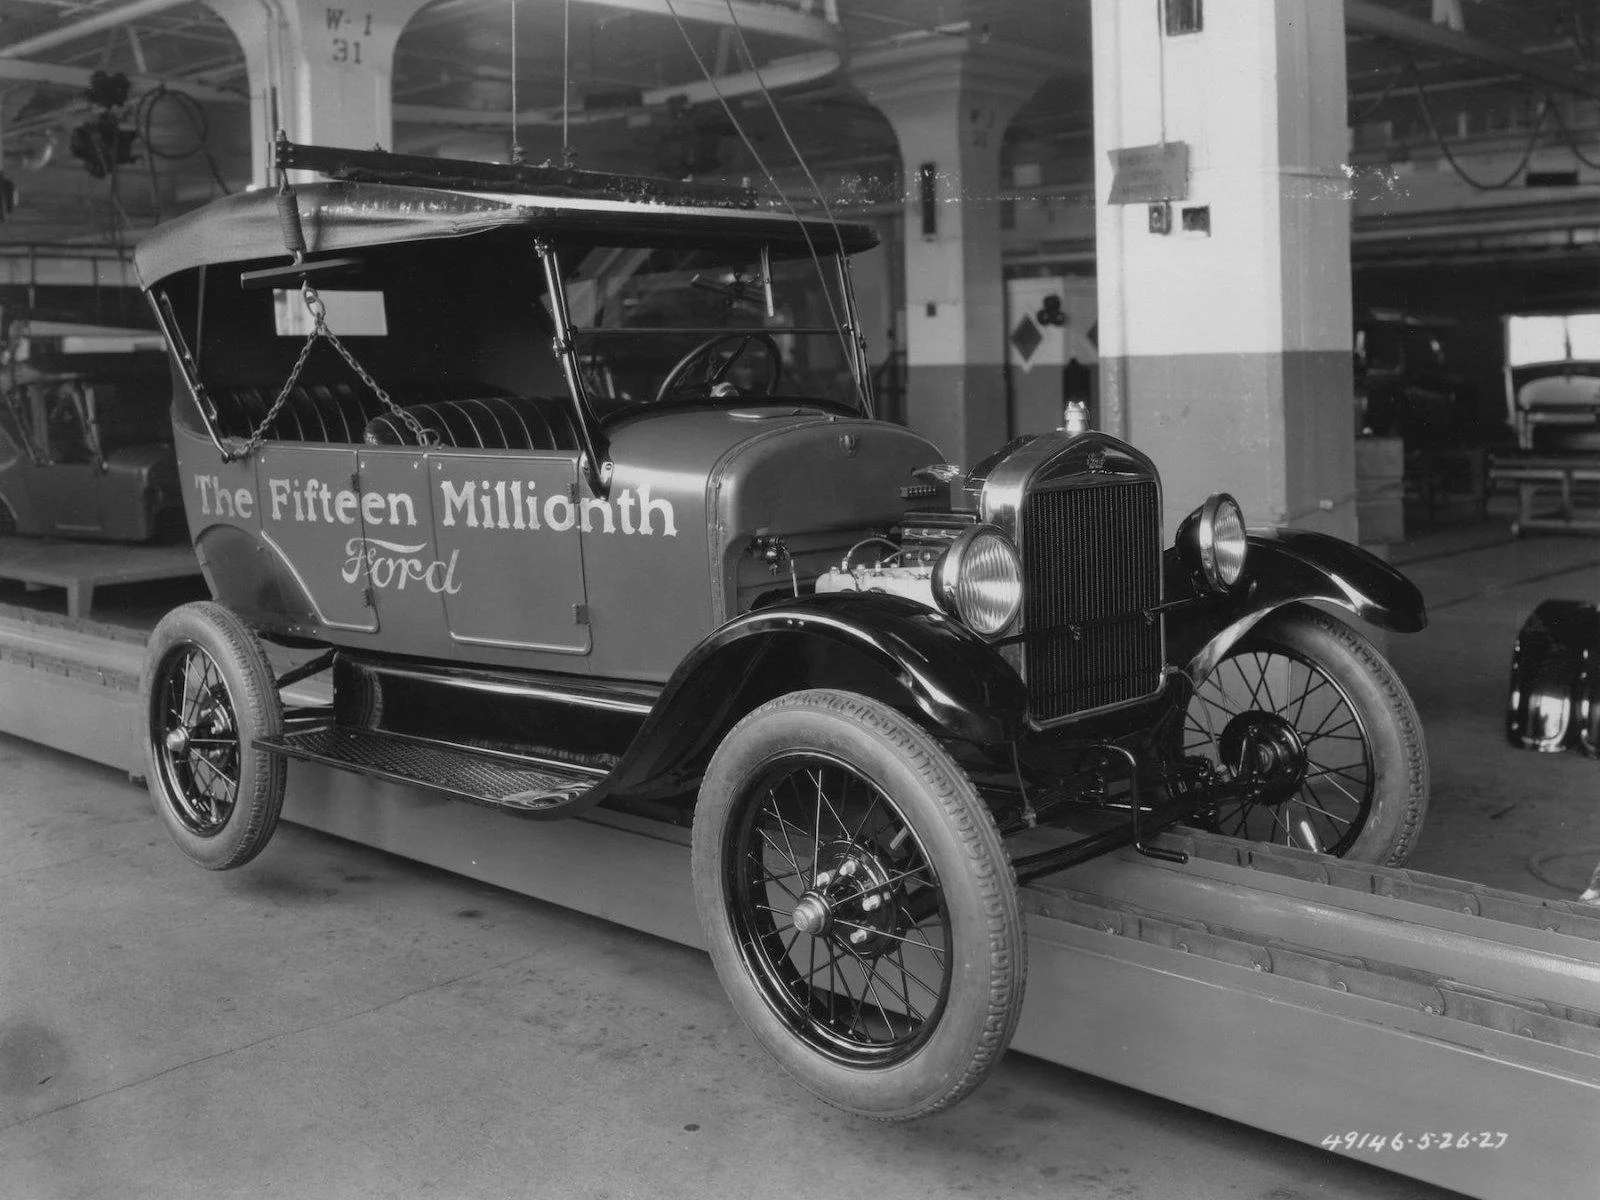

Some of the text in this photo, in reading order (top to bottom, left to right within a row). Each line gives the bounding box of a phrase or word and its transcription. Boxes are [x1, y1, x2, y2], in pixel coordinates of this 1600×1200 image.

[332, 38, 362, 64] 31
[194, 474, 677, 537] The Fifteen Millionth
[342, 537, 462, 594] Ford
